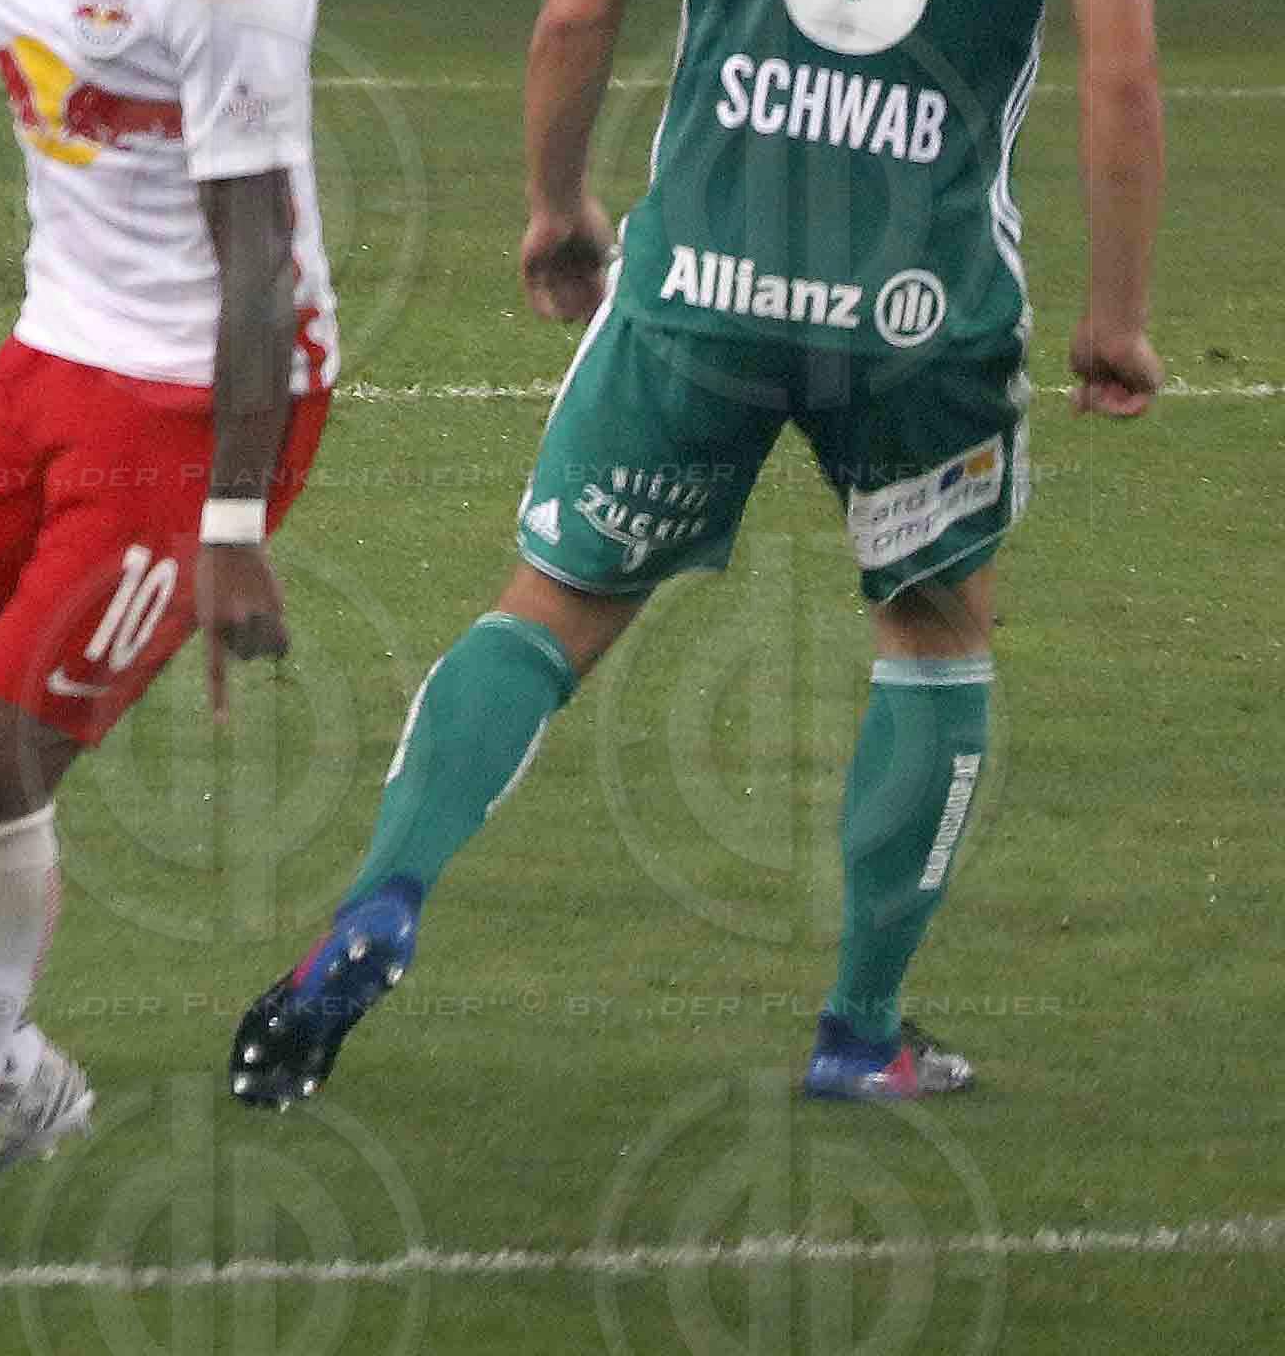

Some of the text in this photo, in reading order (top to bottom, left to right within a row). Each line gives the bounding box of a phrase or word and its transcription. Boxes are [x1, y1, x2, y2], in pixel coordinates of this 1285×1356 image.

[715, 51, 949, 166] SCHWAB
[659, 243, 864, 329] Allianz
[82, 545, 179, 677] 10
